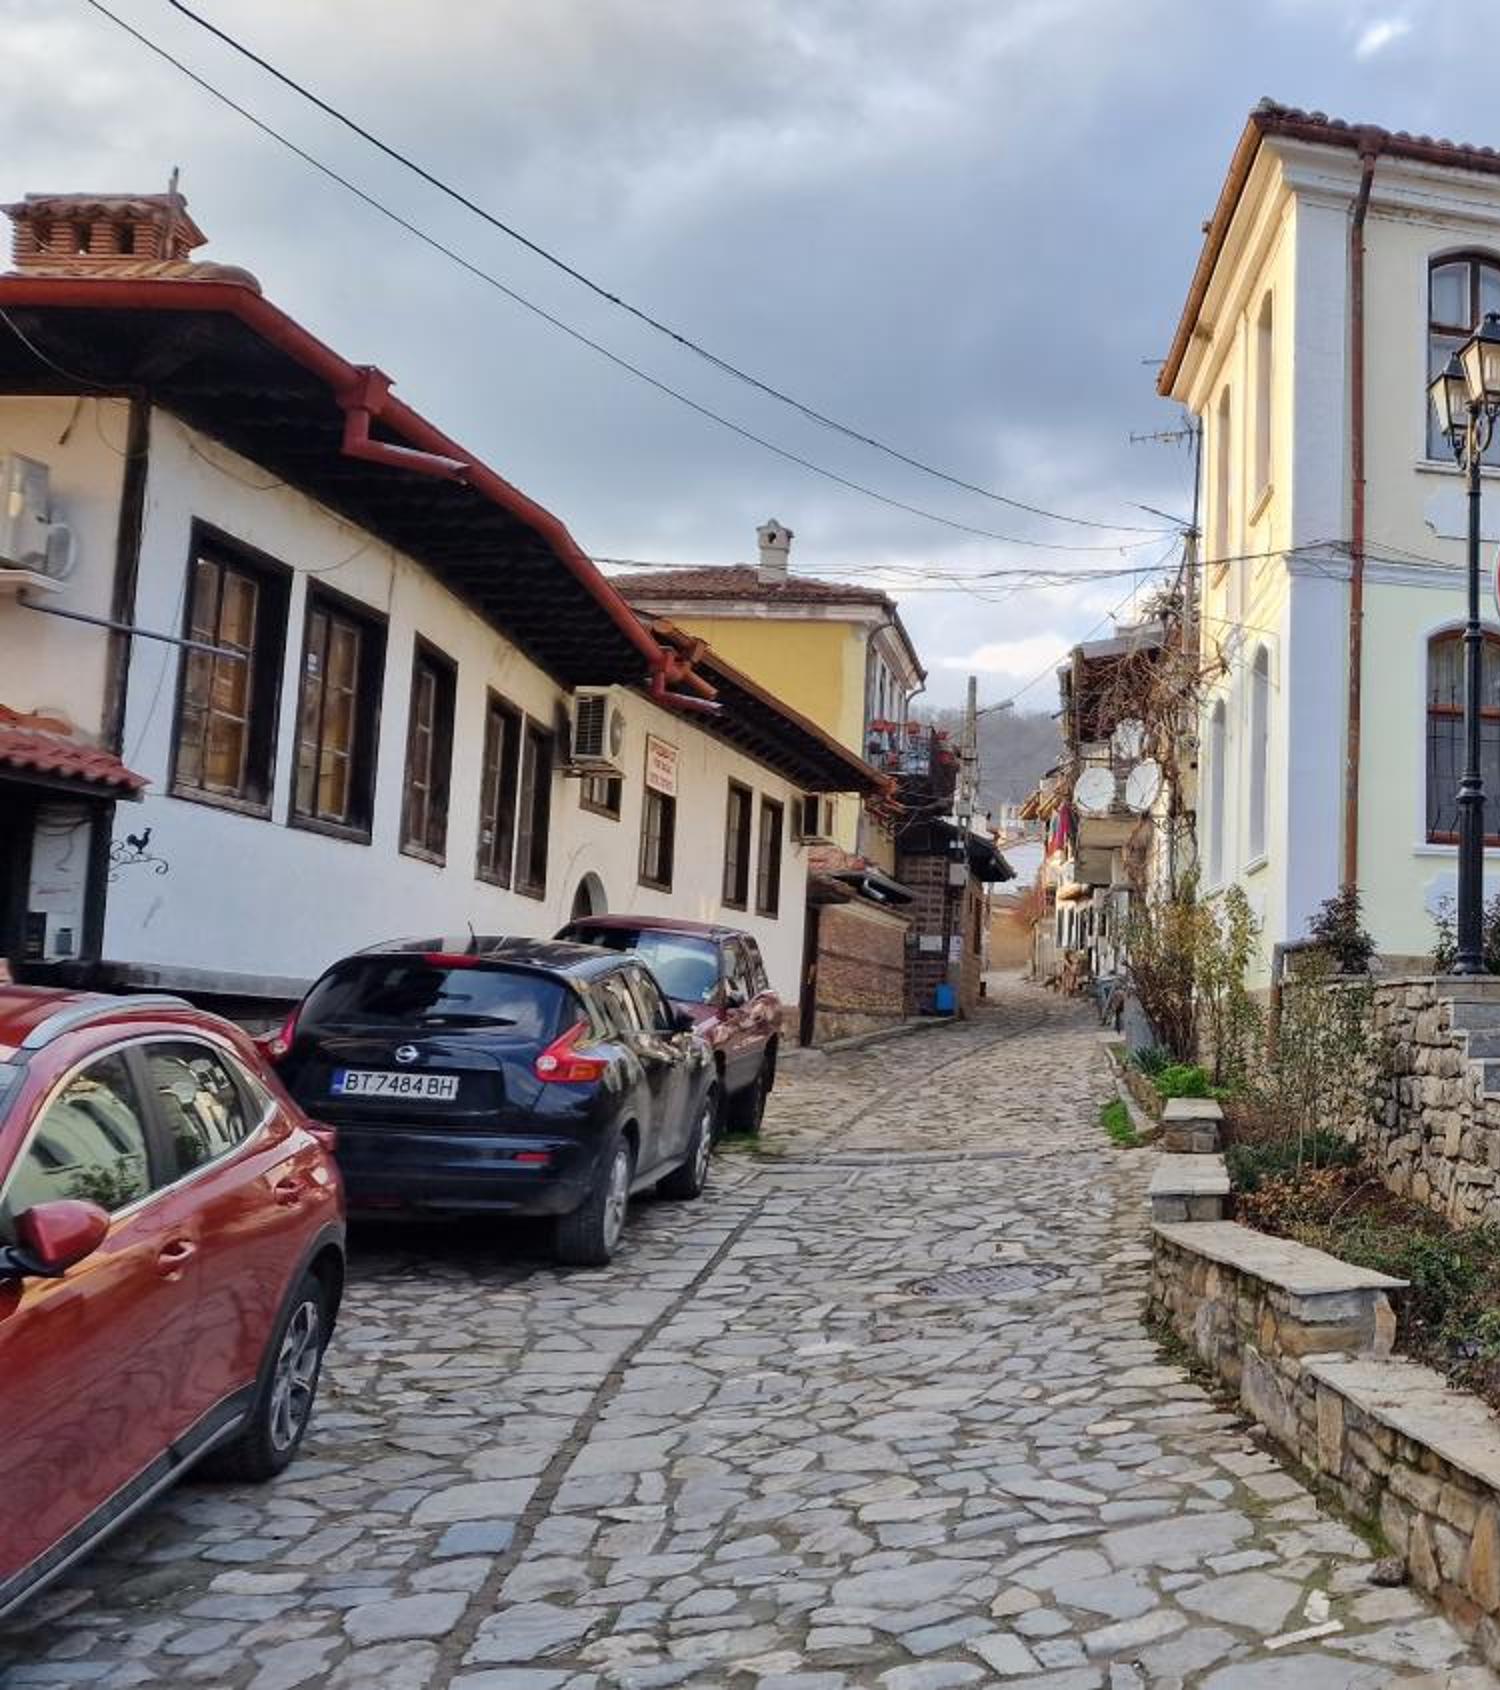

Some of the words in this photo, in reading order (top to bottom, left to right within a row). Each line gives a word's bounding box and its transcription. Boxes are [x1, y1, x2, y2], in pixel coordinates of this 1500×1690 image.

[346, 1073, 372, 1091] BT
[375, 1075, 422, 1094] 7484
[427, 1077, 453, 1096] BH
